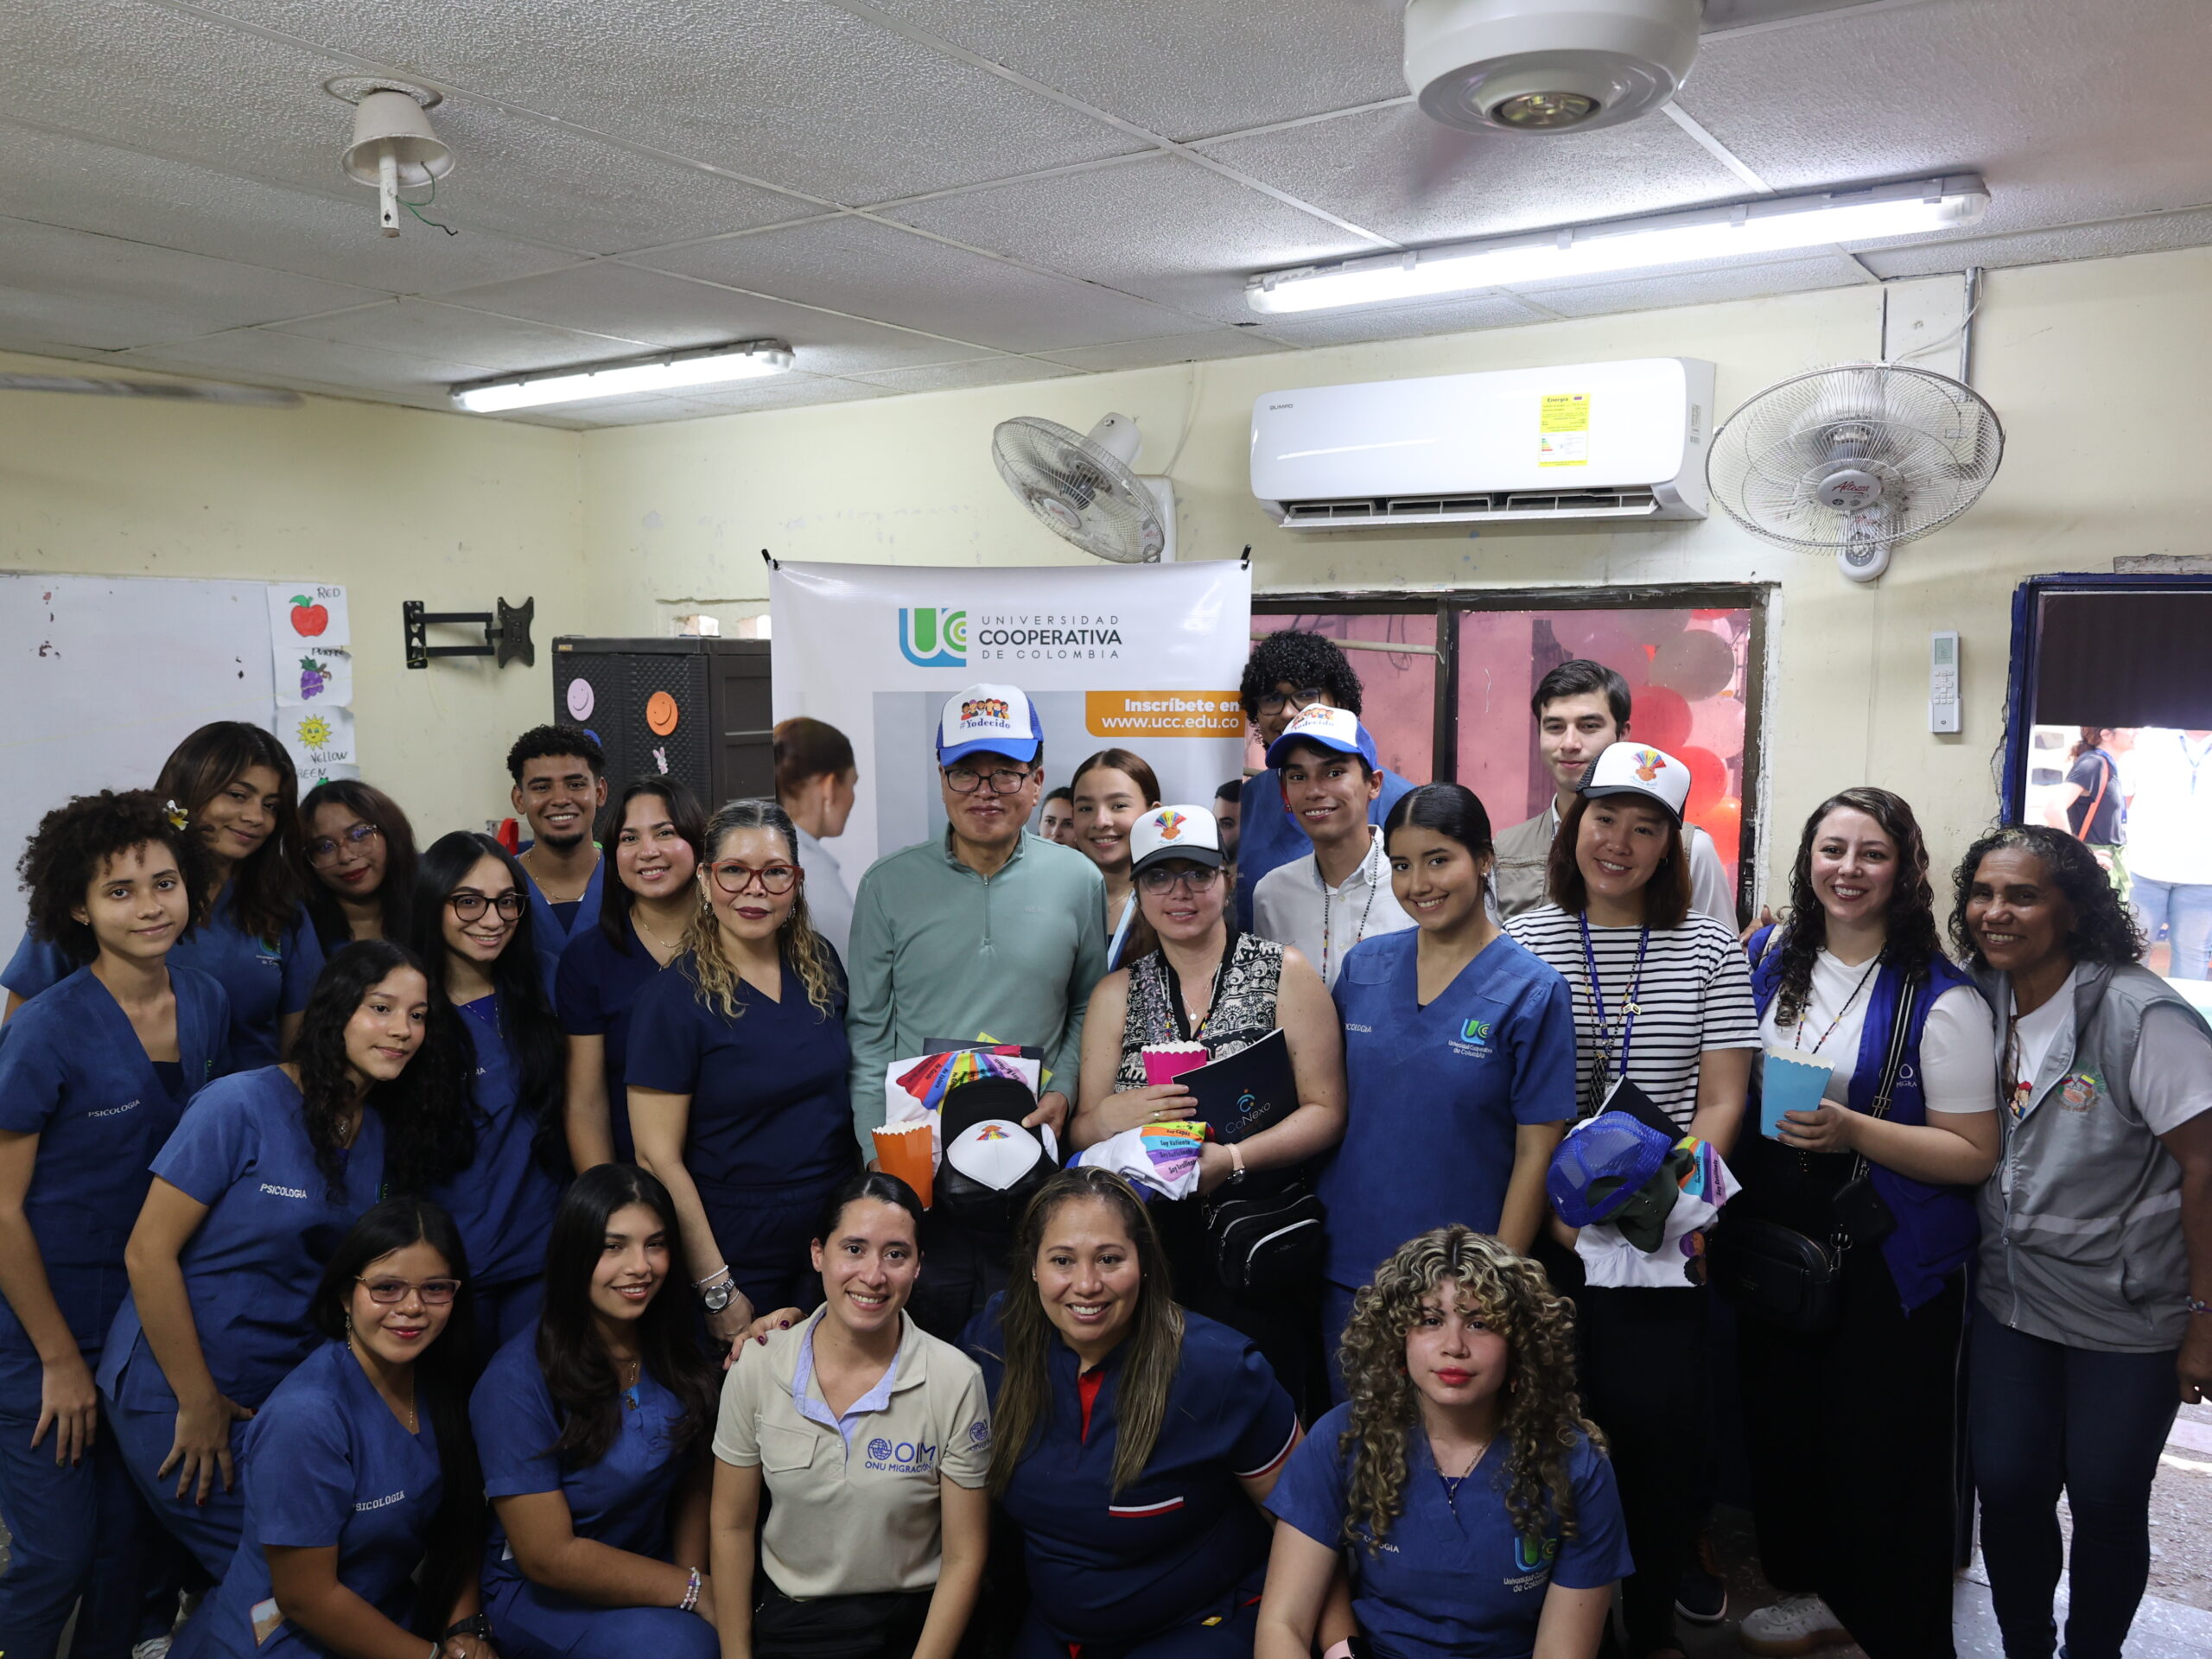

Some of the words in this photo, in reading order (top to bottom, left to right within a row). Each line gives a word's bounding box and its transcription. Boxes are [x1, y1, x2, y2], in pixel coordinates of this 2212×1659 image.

[317, 587, 340, 599] RED
[982, 615, 1119, 625] UNIVERSIDAD
[978, 629, 1122, 645] COOPERATIVA
[982, 650, 1004, 659] DE
[1016, 650, 1120, 659] COLOMBIA
[1125, 698, 1215, 713] Inscríbete
[1220, 701, 1241, 713] en
[959, 718, 1011, 730] #Yodecido
[1102, 715, 1239, 729] www.ucc.edu.co
[297, 767, 327, 779] REEN
[88, 1099, 141, 1118] PSICOLOGIA
[1225, 1103, 1271, 1134] CoNexo
[260, 1183, 308, 1199] PSICOLOGIA
[865, 1460, 887, 1471] ONU
[353, 1490, 405, 1512] SICOLOGIA
